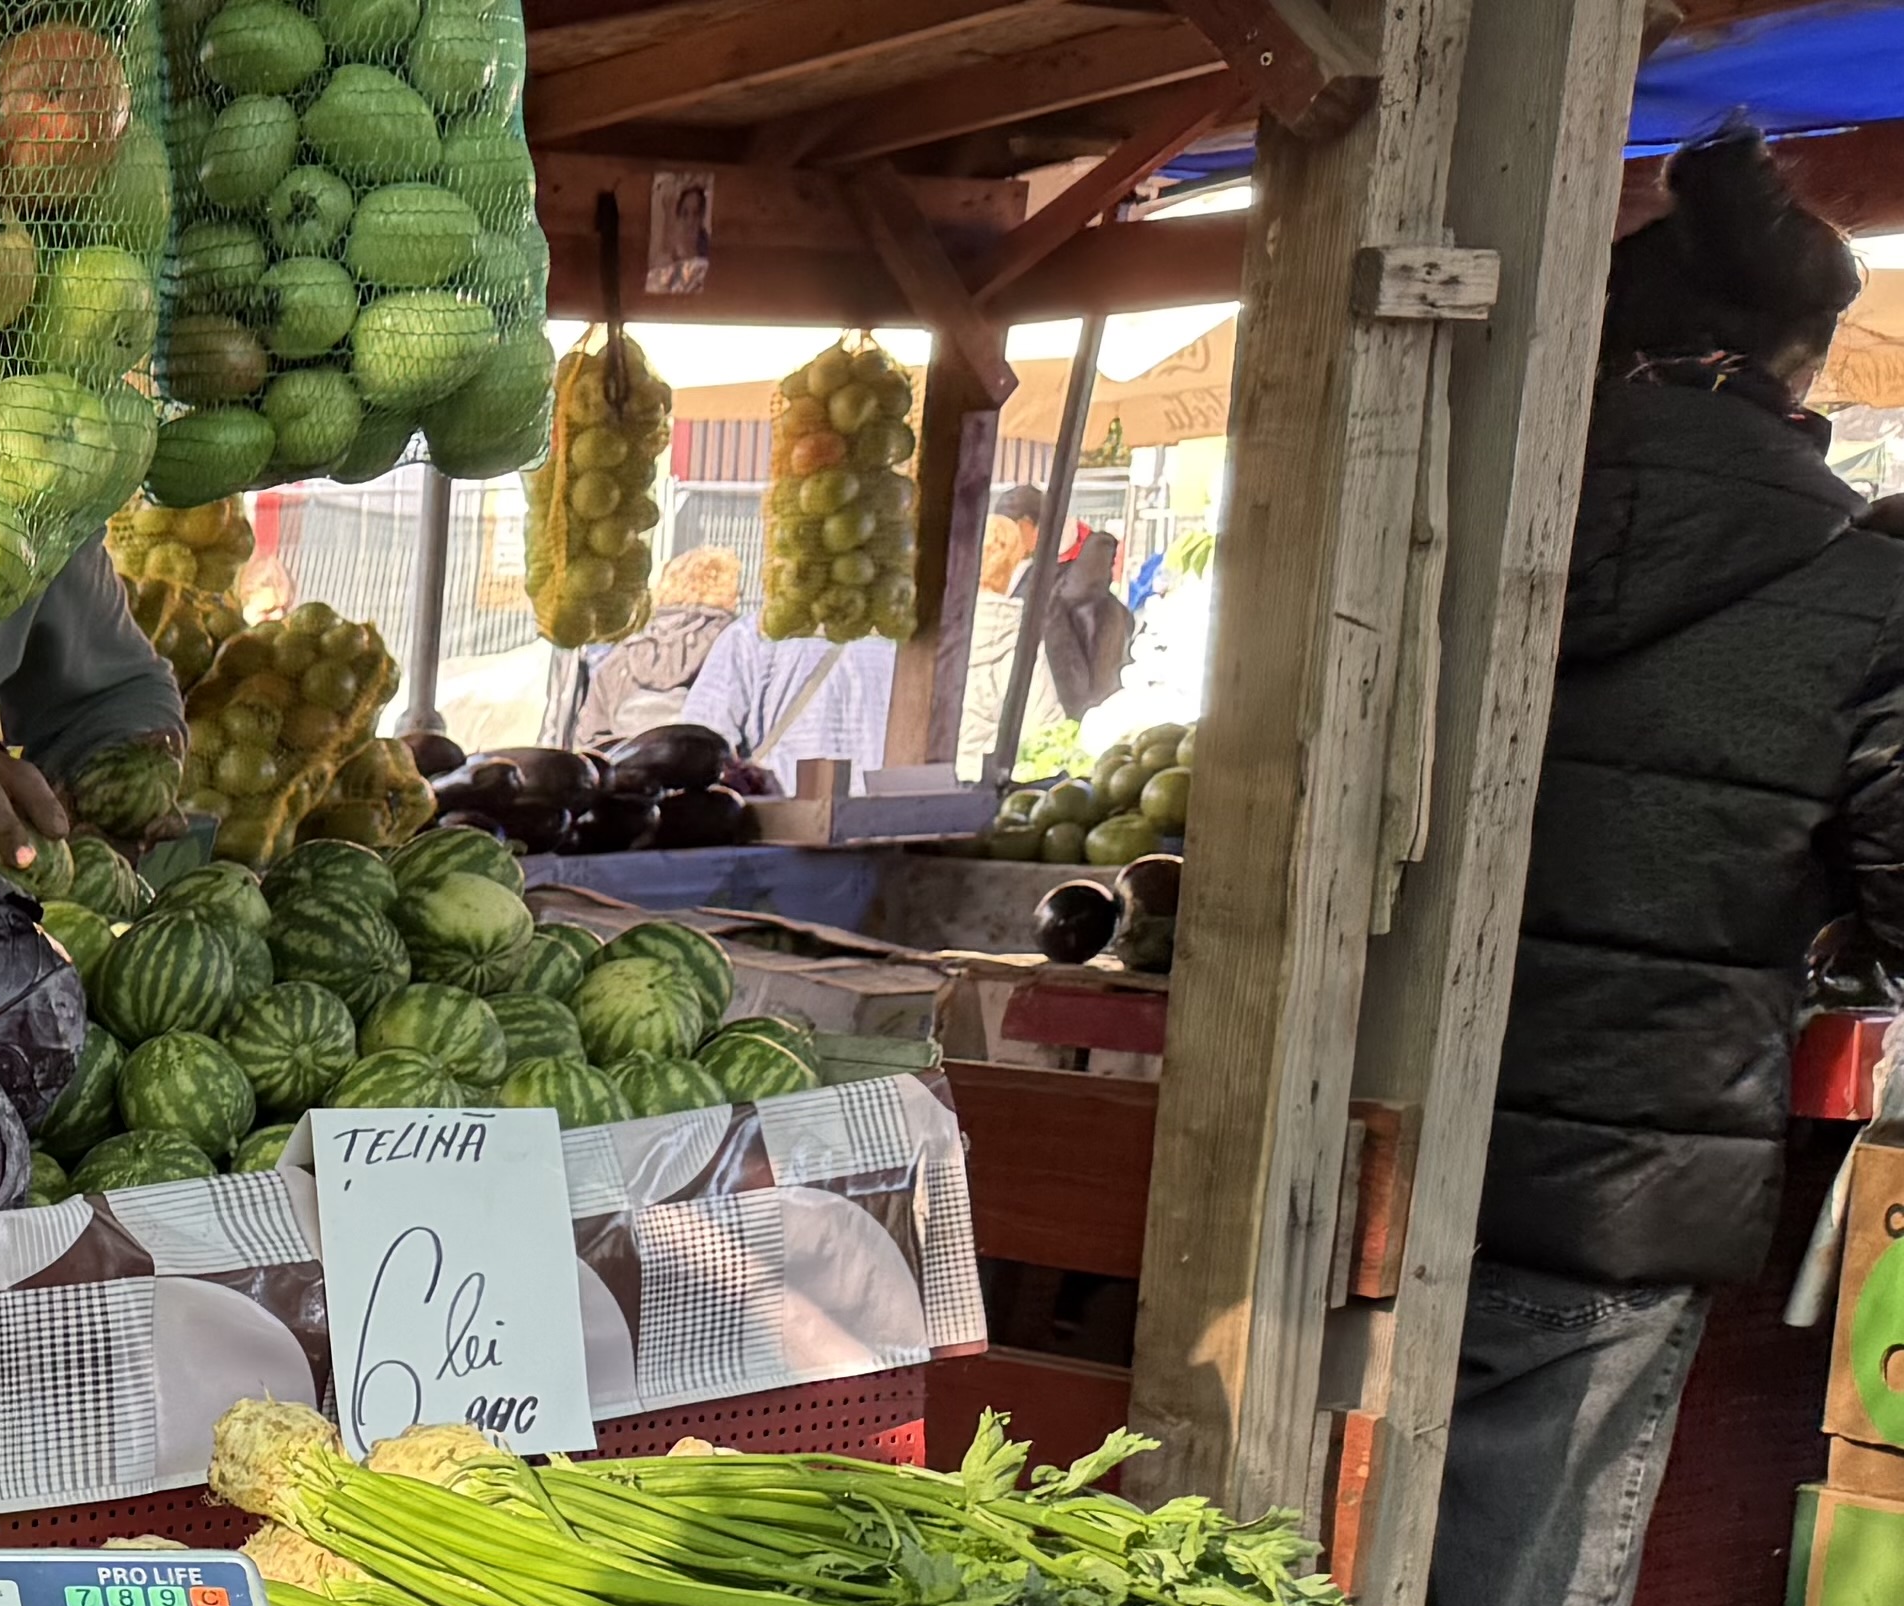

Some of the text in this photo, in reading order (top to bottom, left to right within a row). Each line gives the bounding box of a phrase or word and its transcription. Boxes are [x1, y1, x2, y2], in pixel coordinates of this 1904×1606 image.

[435, 1272, 505, 1380] lei
[97, 1567, 204, 1586] PRO LIFE
[75, 1589, 91, 1606] 7
[201, 1591, 219, 1606] C
